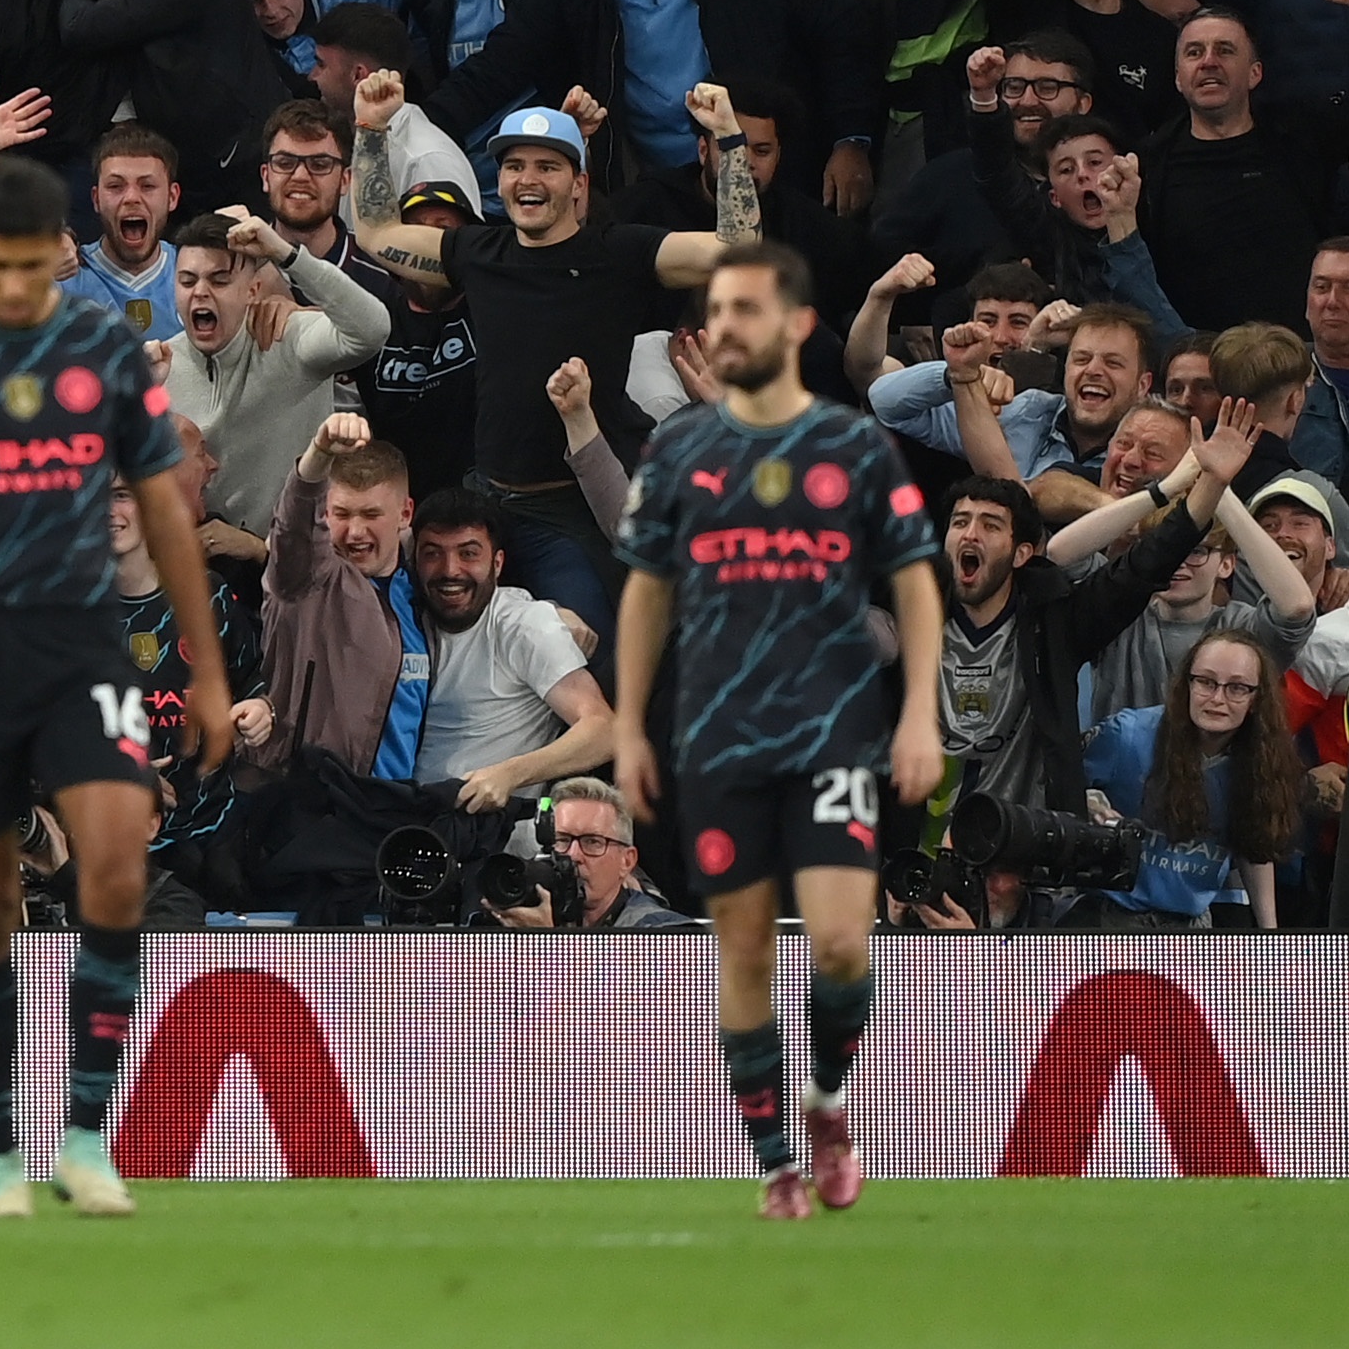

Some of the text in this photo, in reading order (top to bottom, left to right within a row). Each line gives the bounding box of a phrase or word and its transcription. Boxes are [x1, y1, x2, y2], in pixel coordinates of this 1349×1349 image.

[377, 245, 410, 267] JUST
[689, 529, 852, 563] ETIHAD
[90, 683, 152, 746] 16
[812, 767, 879, 828] 20
